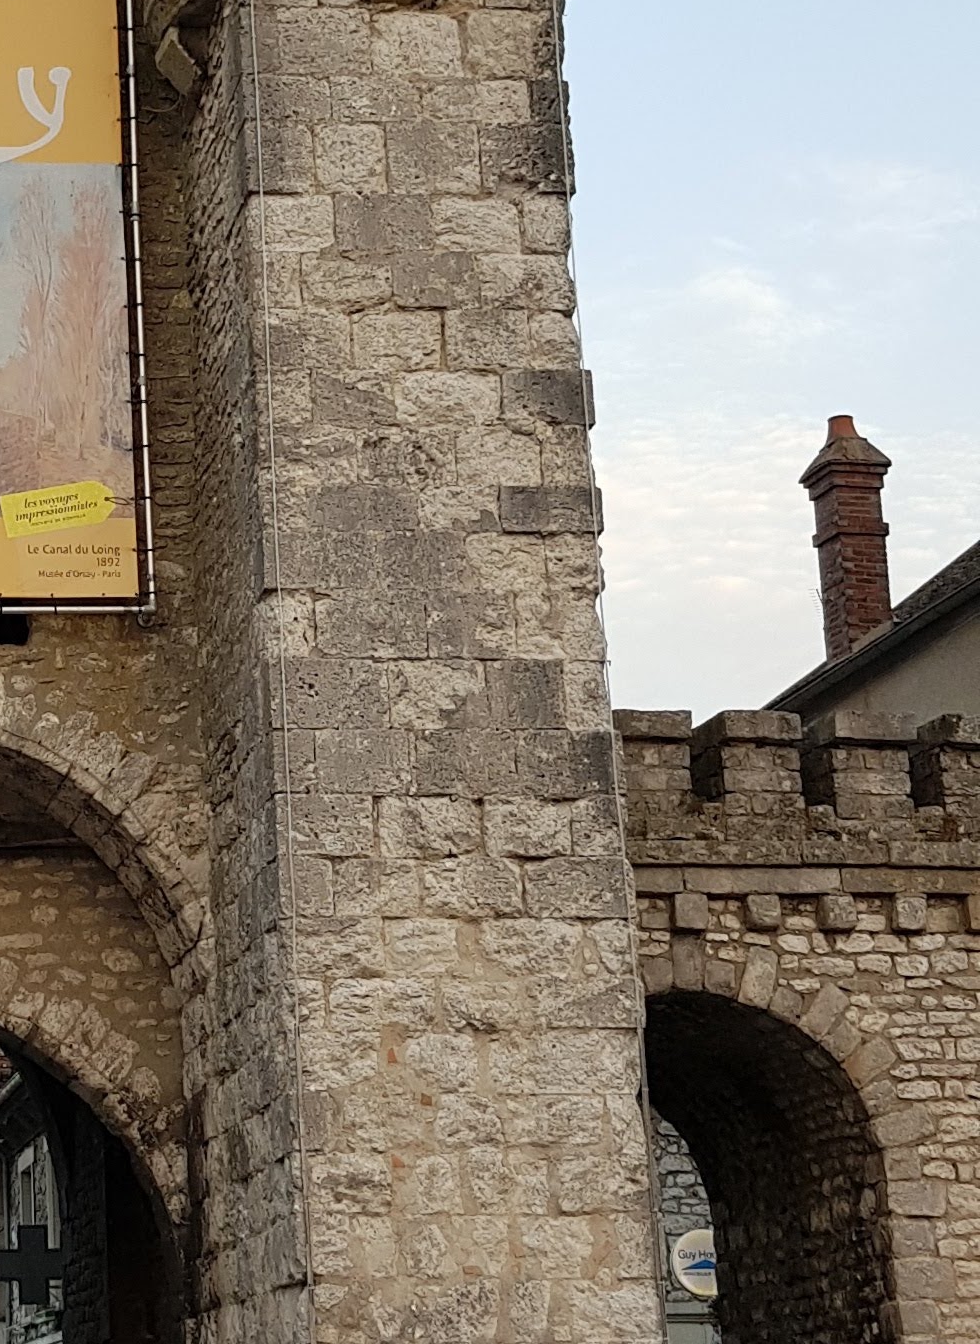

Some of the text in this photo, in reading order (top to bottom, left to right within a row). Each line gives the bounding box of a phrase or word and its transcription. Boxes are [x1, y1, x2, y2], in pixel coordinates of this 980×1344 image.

[27, 544, 121, 557] Le Canal du Loing
[96, 557, 121, 568] 1892
[678, 1250, 696, 1261] Guy
